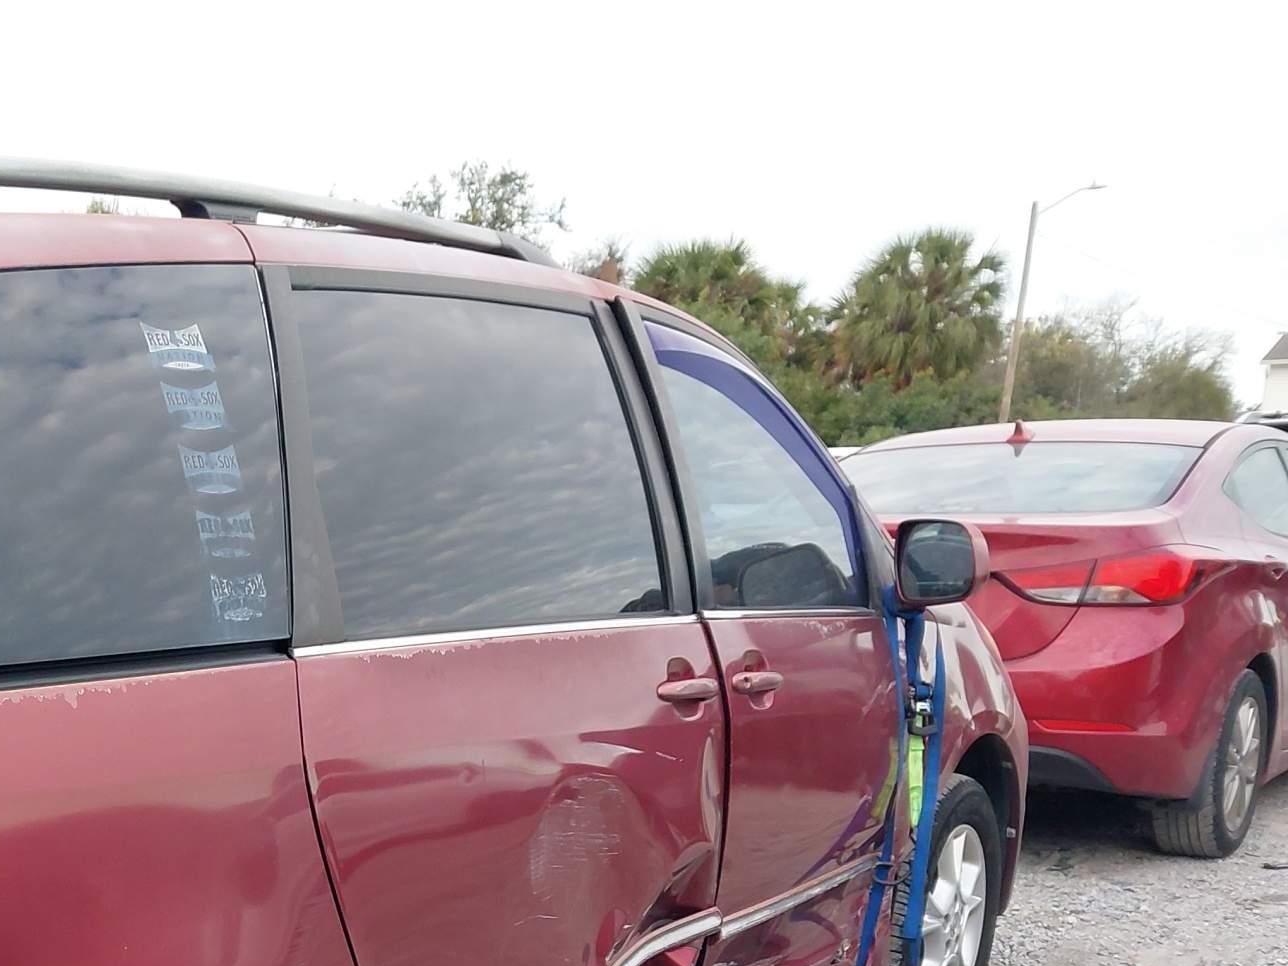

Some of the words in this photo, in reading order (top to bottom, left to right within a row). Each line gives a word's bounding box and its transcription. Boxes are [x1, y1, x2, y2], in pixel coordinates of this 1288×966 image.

[146, 331, 170, 347] RED
[181, 331, 203, 348] SOX
[165, 390, 188, 406] RED
[199, 390, 222, 406] SOX
[183, 454, 205, 469] RED
[216, 454, 238, 470] SOX
